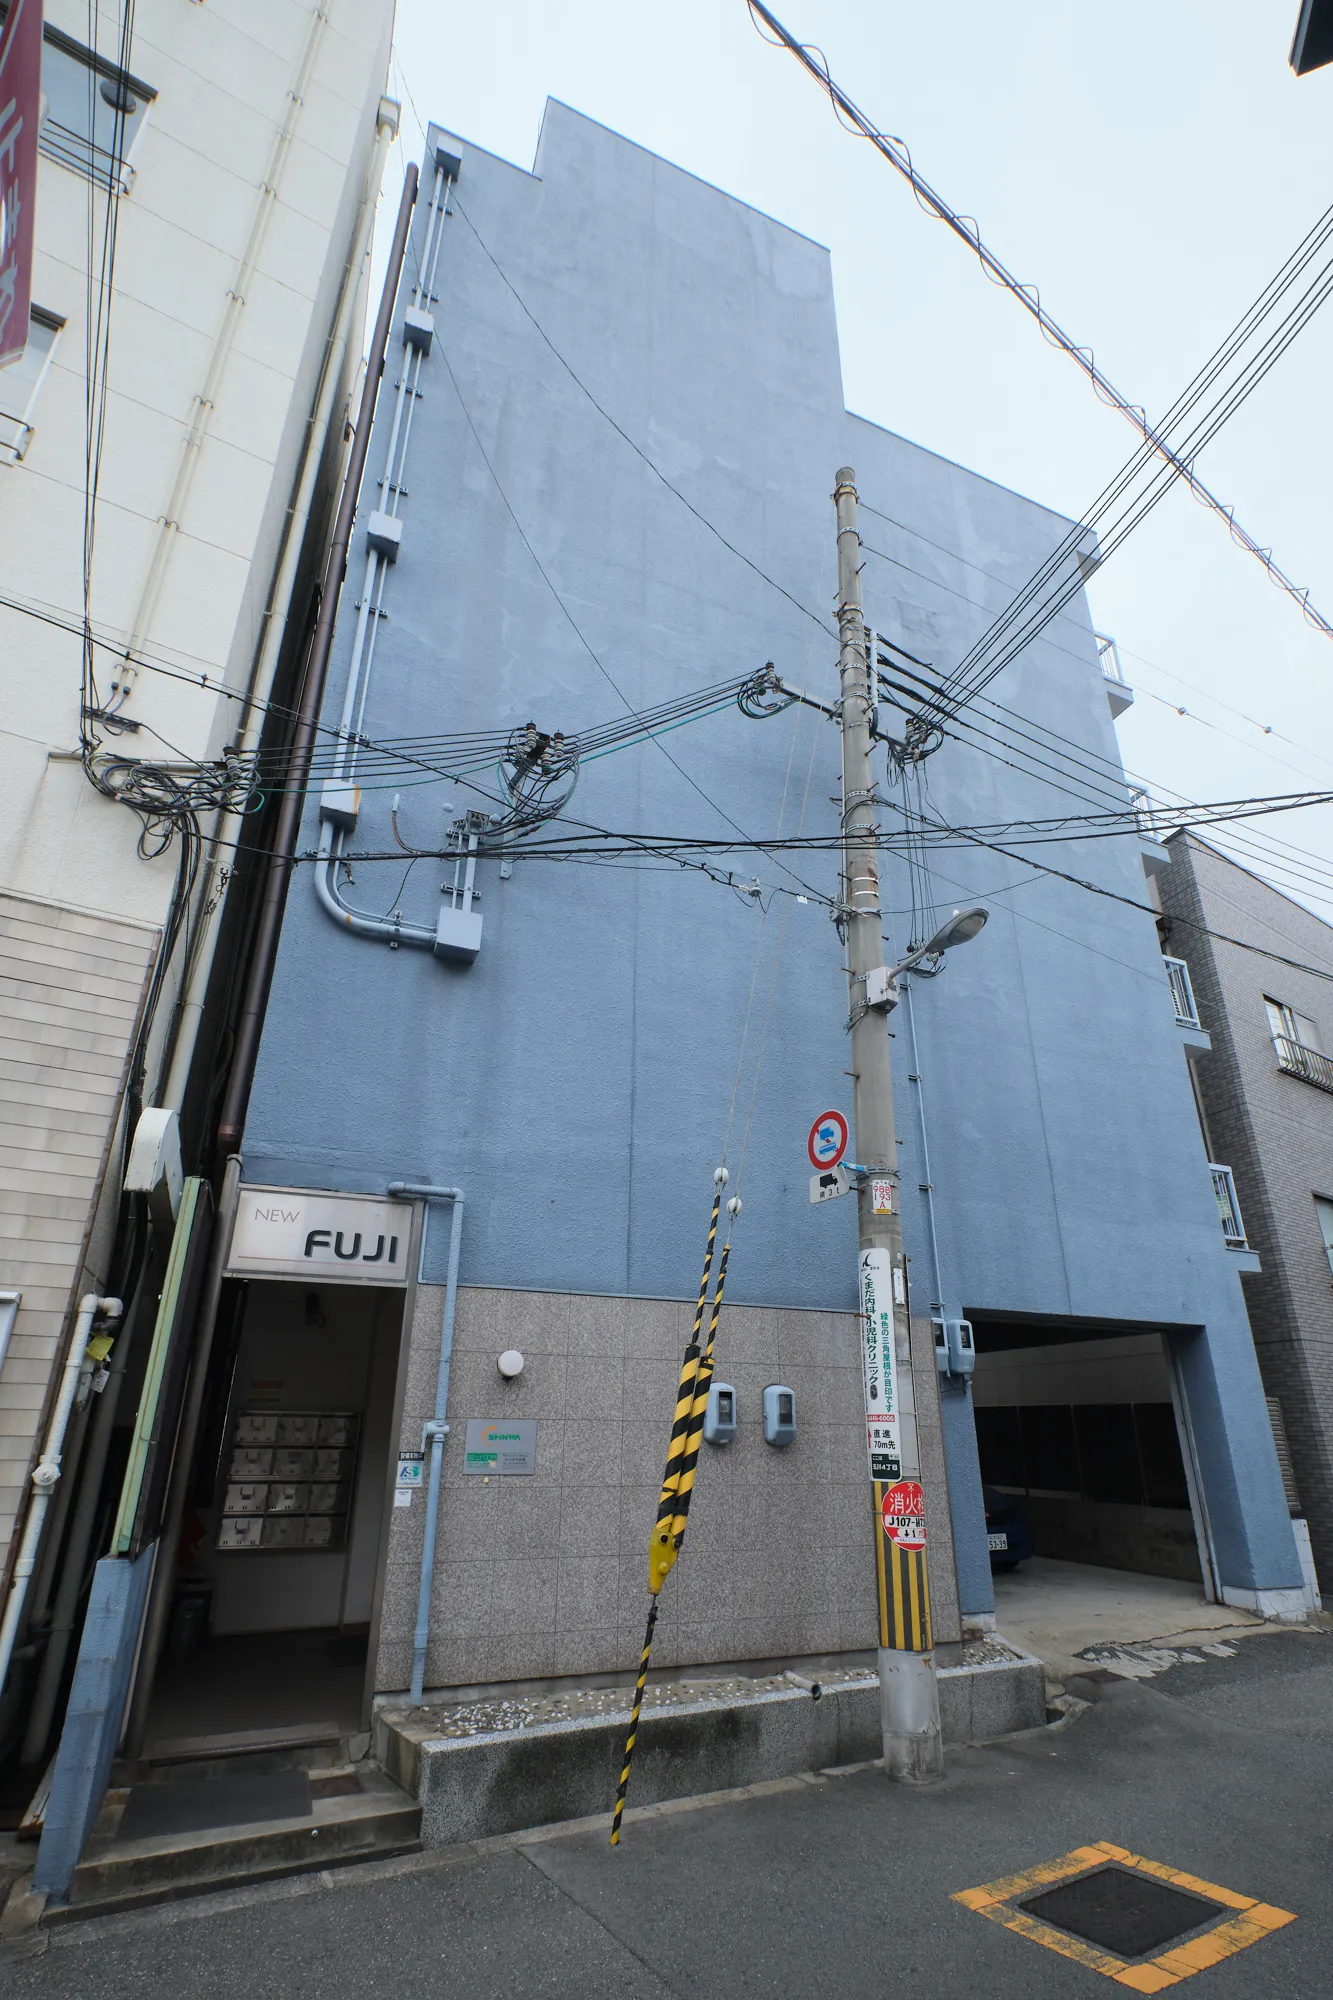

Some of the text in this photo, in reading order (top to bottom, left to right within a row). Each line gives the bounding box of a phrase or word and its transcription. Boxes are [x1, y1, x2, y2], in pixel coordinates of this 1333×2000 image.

[255, 1208, 300, 1223] NEW
[304, 1230, 398, 1262] FUJI
[881, 1313, 893, 1412] 緑色の三角屋根が目印です
[874, 1441, 895, 1449] 70m先
